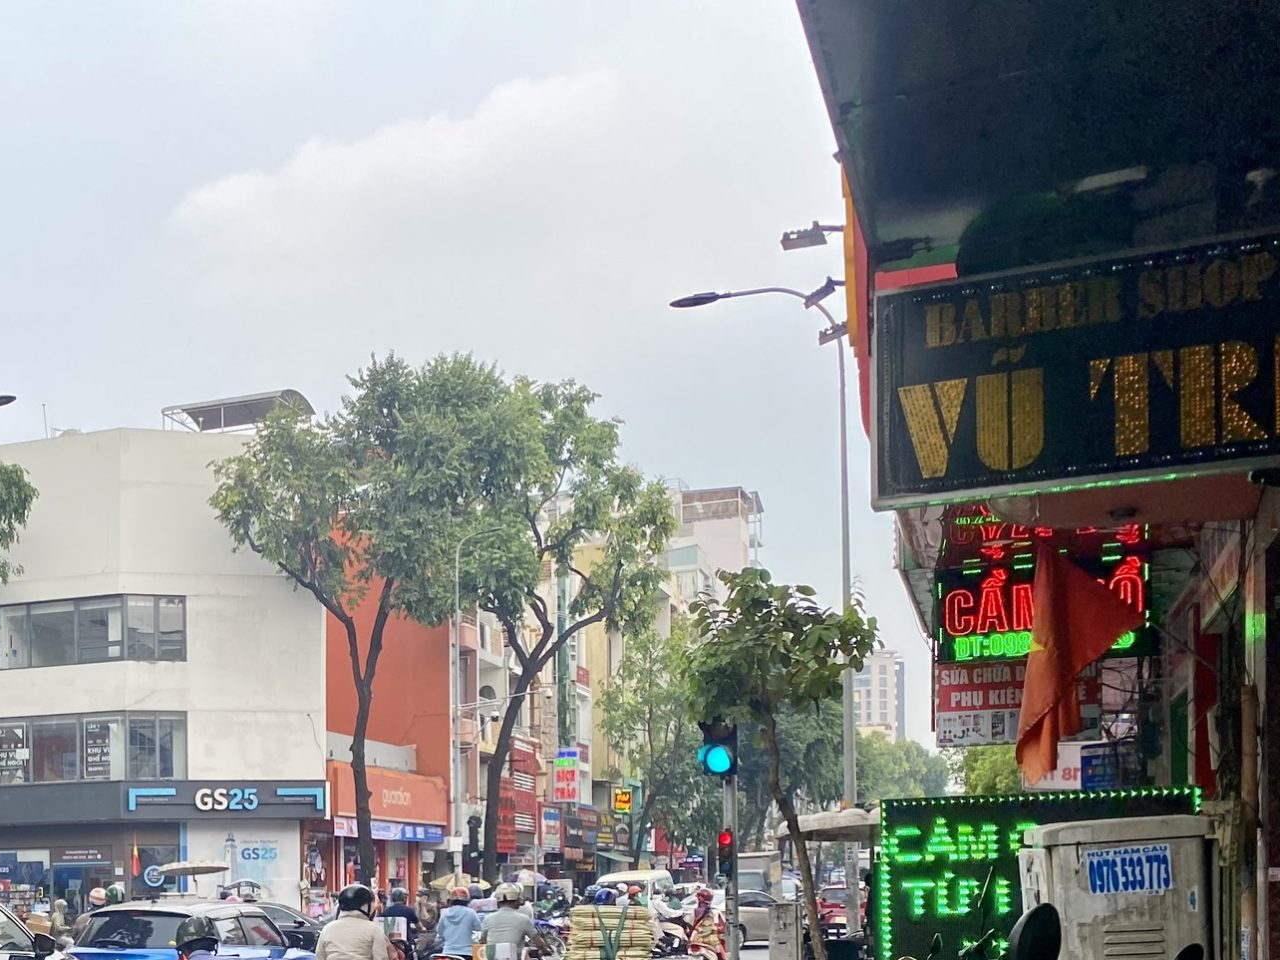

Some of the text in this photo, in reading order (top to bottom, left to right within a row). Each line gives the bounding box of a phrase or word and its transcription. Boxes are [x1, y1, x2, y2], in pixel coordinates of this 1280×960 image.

[925, 251, 1276, 349] BARBER SHOP
[898, 332, 1280, 479] VŨ TR
[941, 665, 969, 686] SỬA
[973, 663, 1012, 685] CHỮA
[951, 691, 984, 709] PHỤ
[195, 787, 259, 811] GS25
[241, 847, 278, 860] GS25
[1087, 845, 1168, 858] HUT HAM CAU
